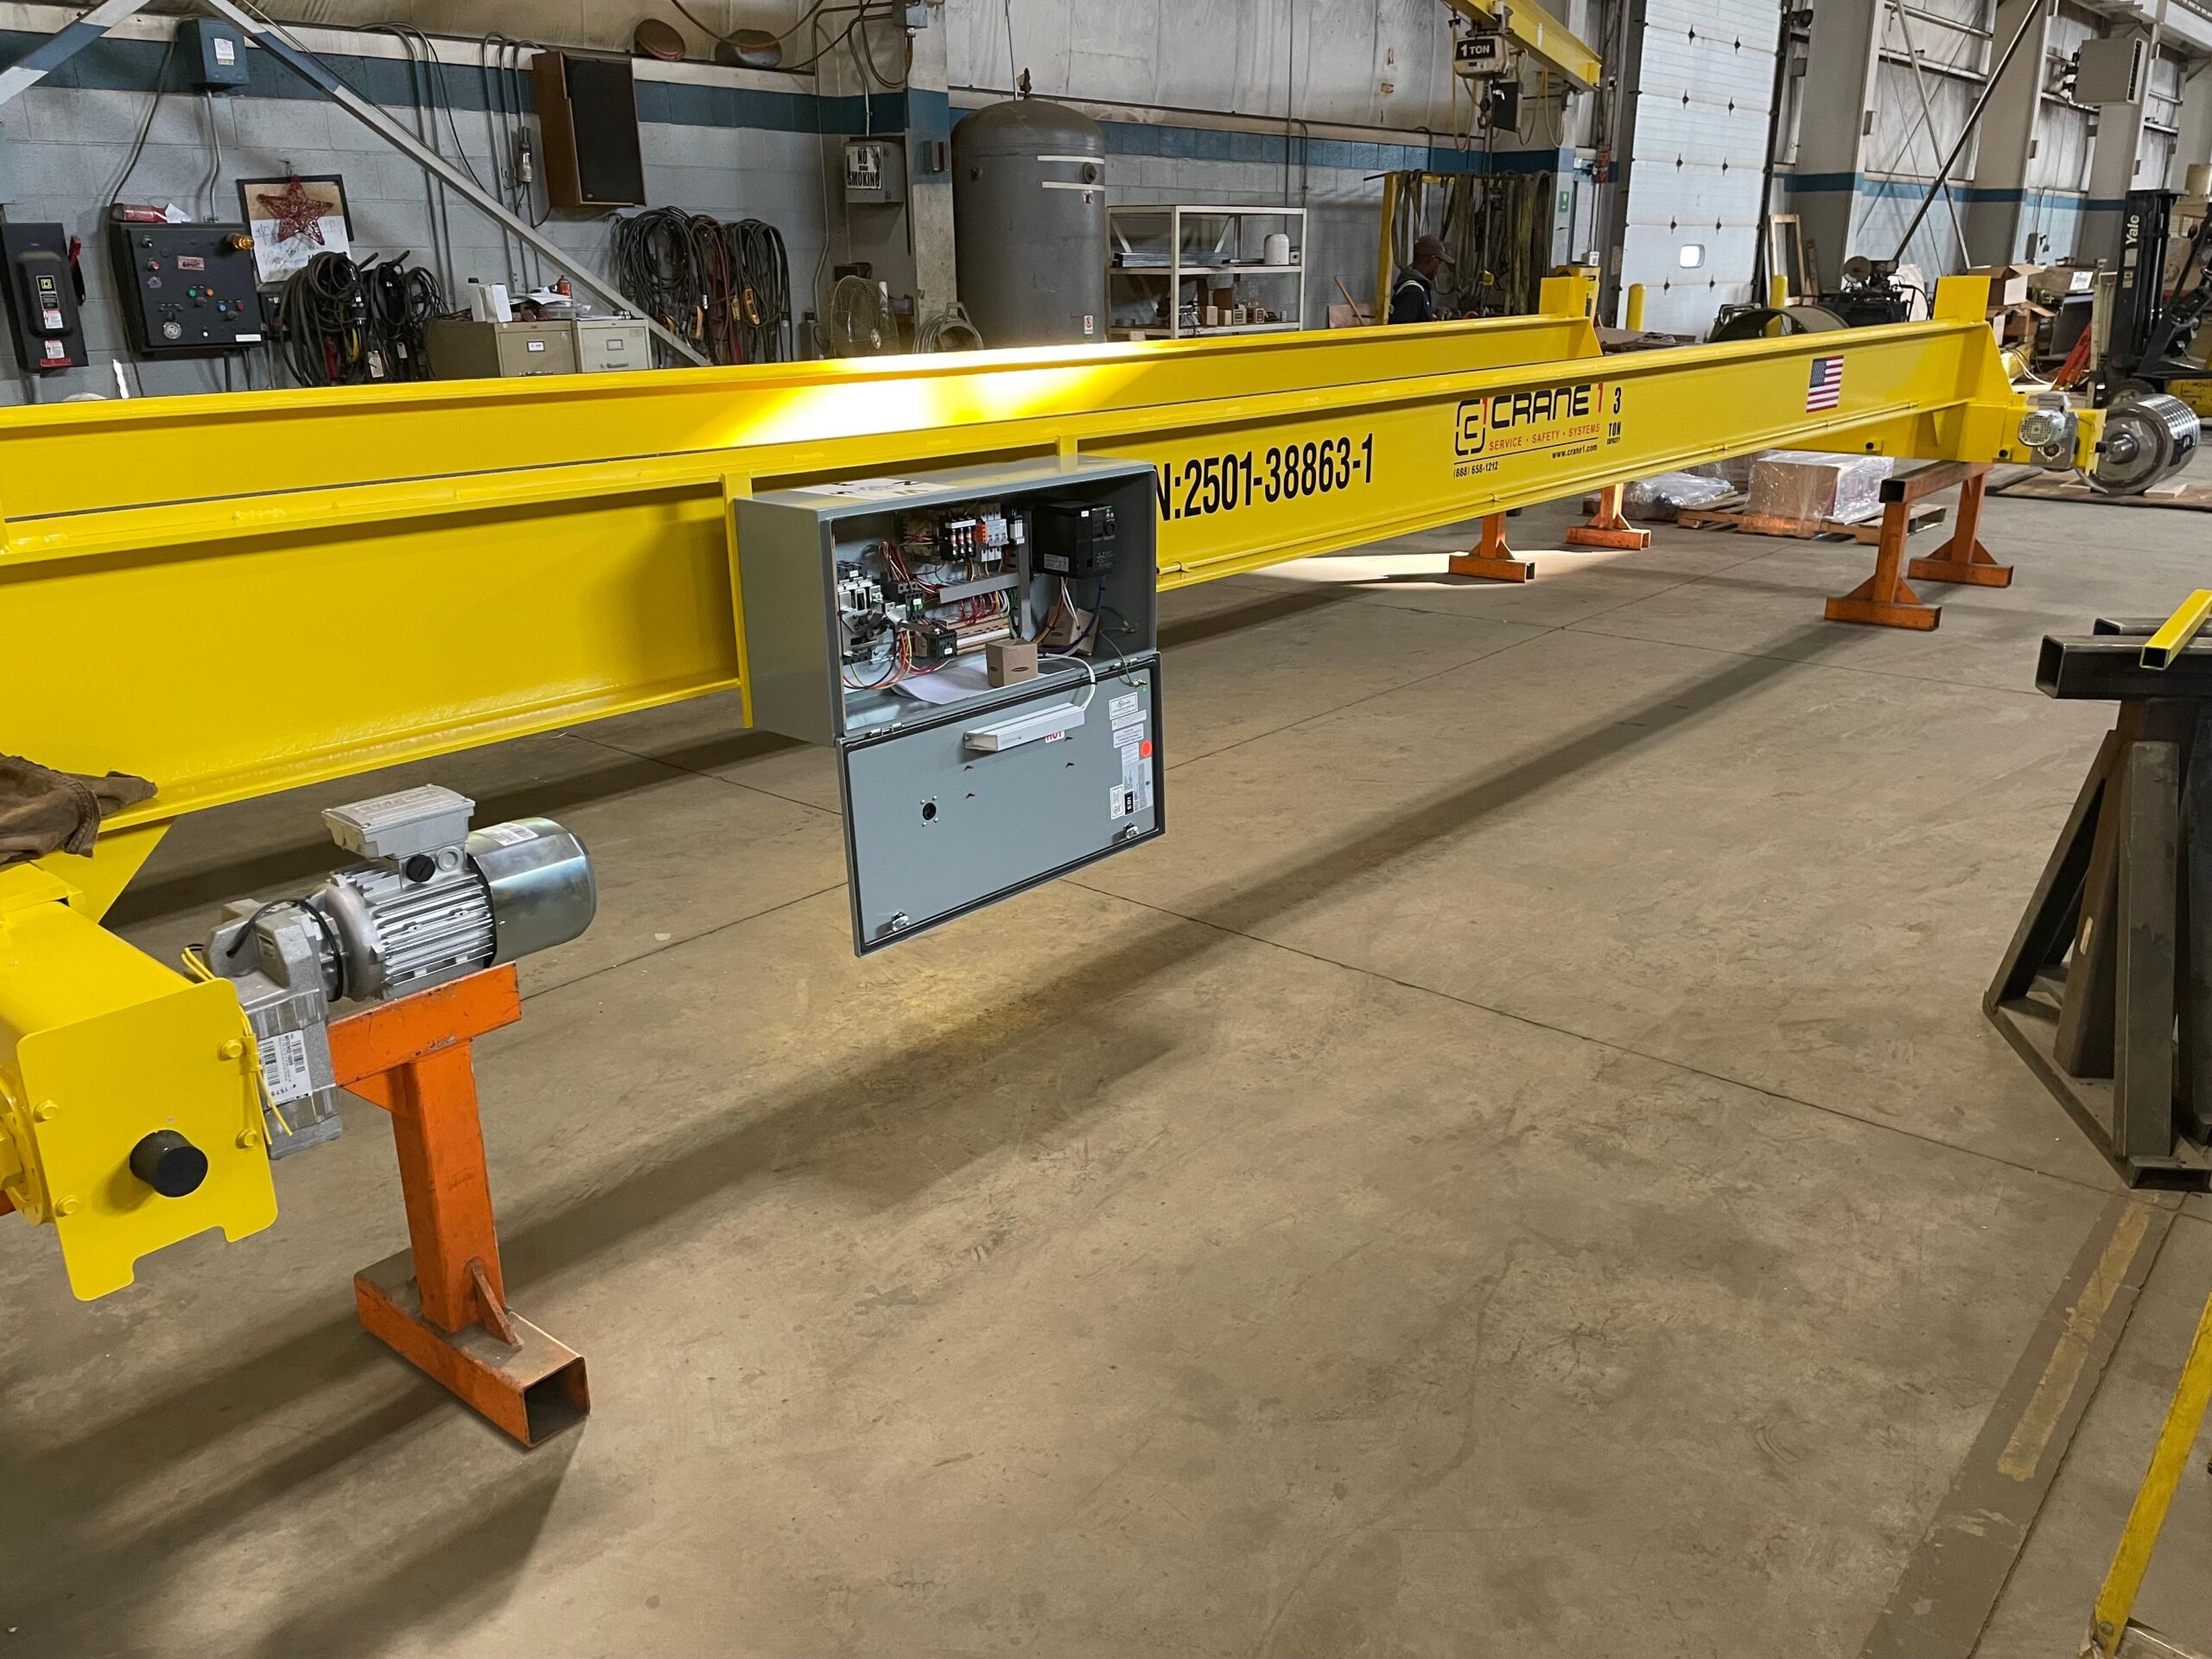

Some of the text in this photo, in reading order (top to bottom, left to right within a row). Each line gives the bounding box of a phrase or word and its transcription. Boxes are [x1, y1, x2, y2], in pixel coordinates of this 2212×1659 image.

[1460, 43, 1491, 57] 1 TON
[857, 149, 868, 165] NO
[847, 170, 880, 188] SMOKING
[2125, 214, 2140, 245] Yale
[1491, 384, 1592, 429] CRANE
[1612, 386, 1622, 415] 3
[1489, 423, 1601, 451] SERVICE SAFETY SYSTEMS
[1608, 421, 1622, 437] TON
[1552, 443, 1599, 460] www.crane1.com
